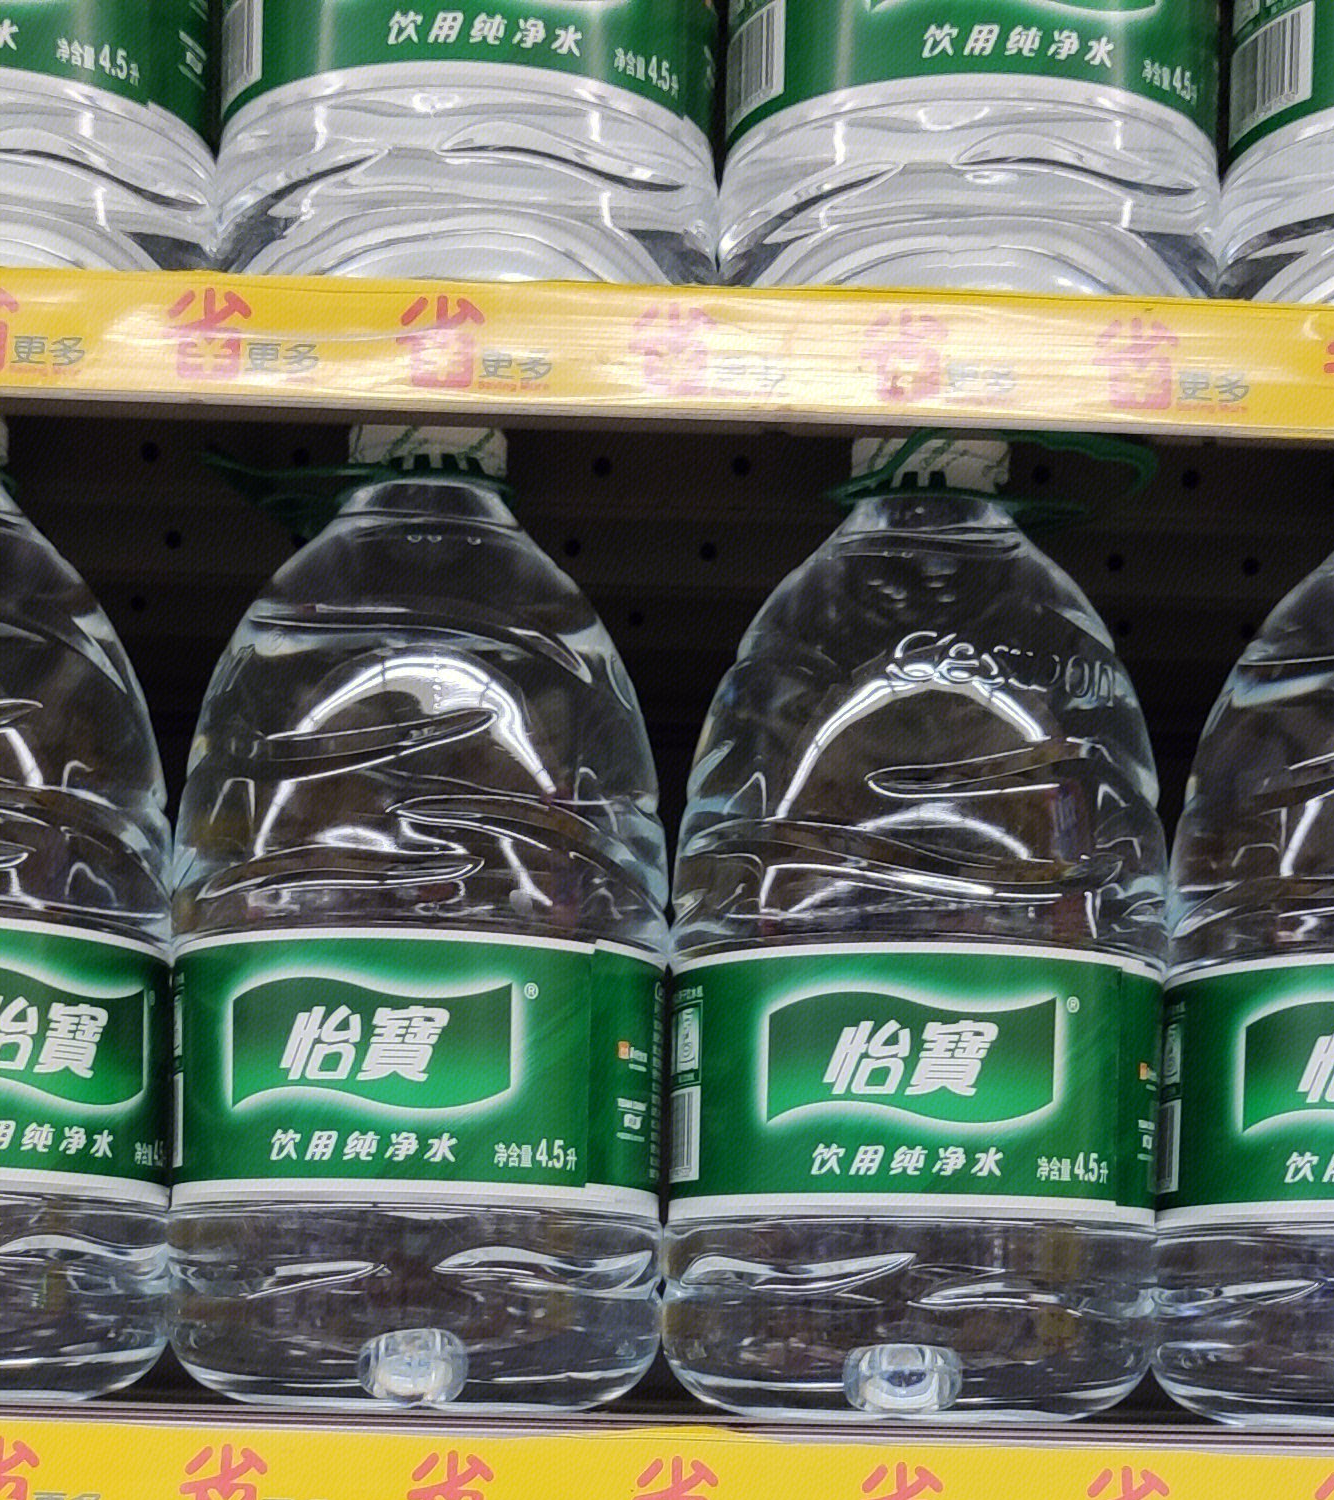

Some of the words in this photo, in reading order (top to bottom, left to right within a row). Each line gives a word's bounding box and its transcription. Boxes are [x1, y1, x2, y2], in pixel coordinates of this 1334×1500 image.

[386, 10, 583, 58] 饮用纯净水
[920, 23, 1116, 68] 饮用纯净水
[12, 335, 86, 366] 更多
[269, 1128, 459, 1164] 饮用纯净水
[493, 1138, 579, 1173] 净含量4.5升
[810, 1142, 1005, 1178] 饮用纯净水
[1036, 1152, 1110, 1185] 净含量4.5升
